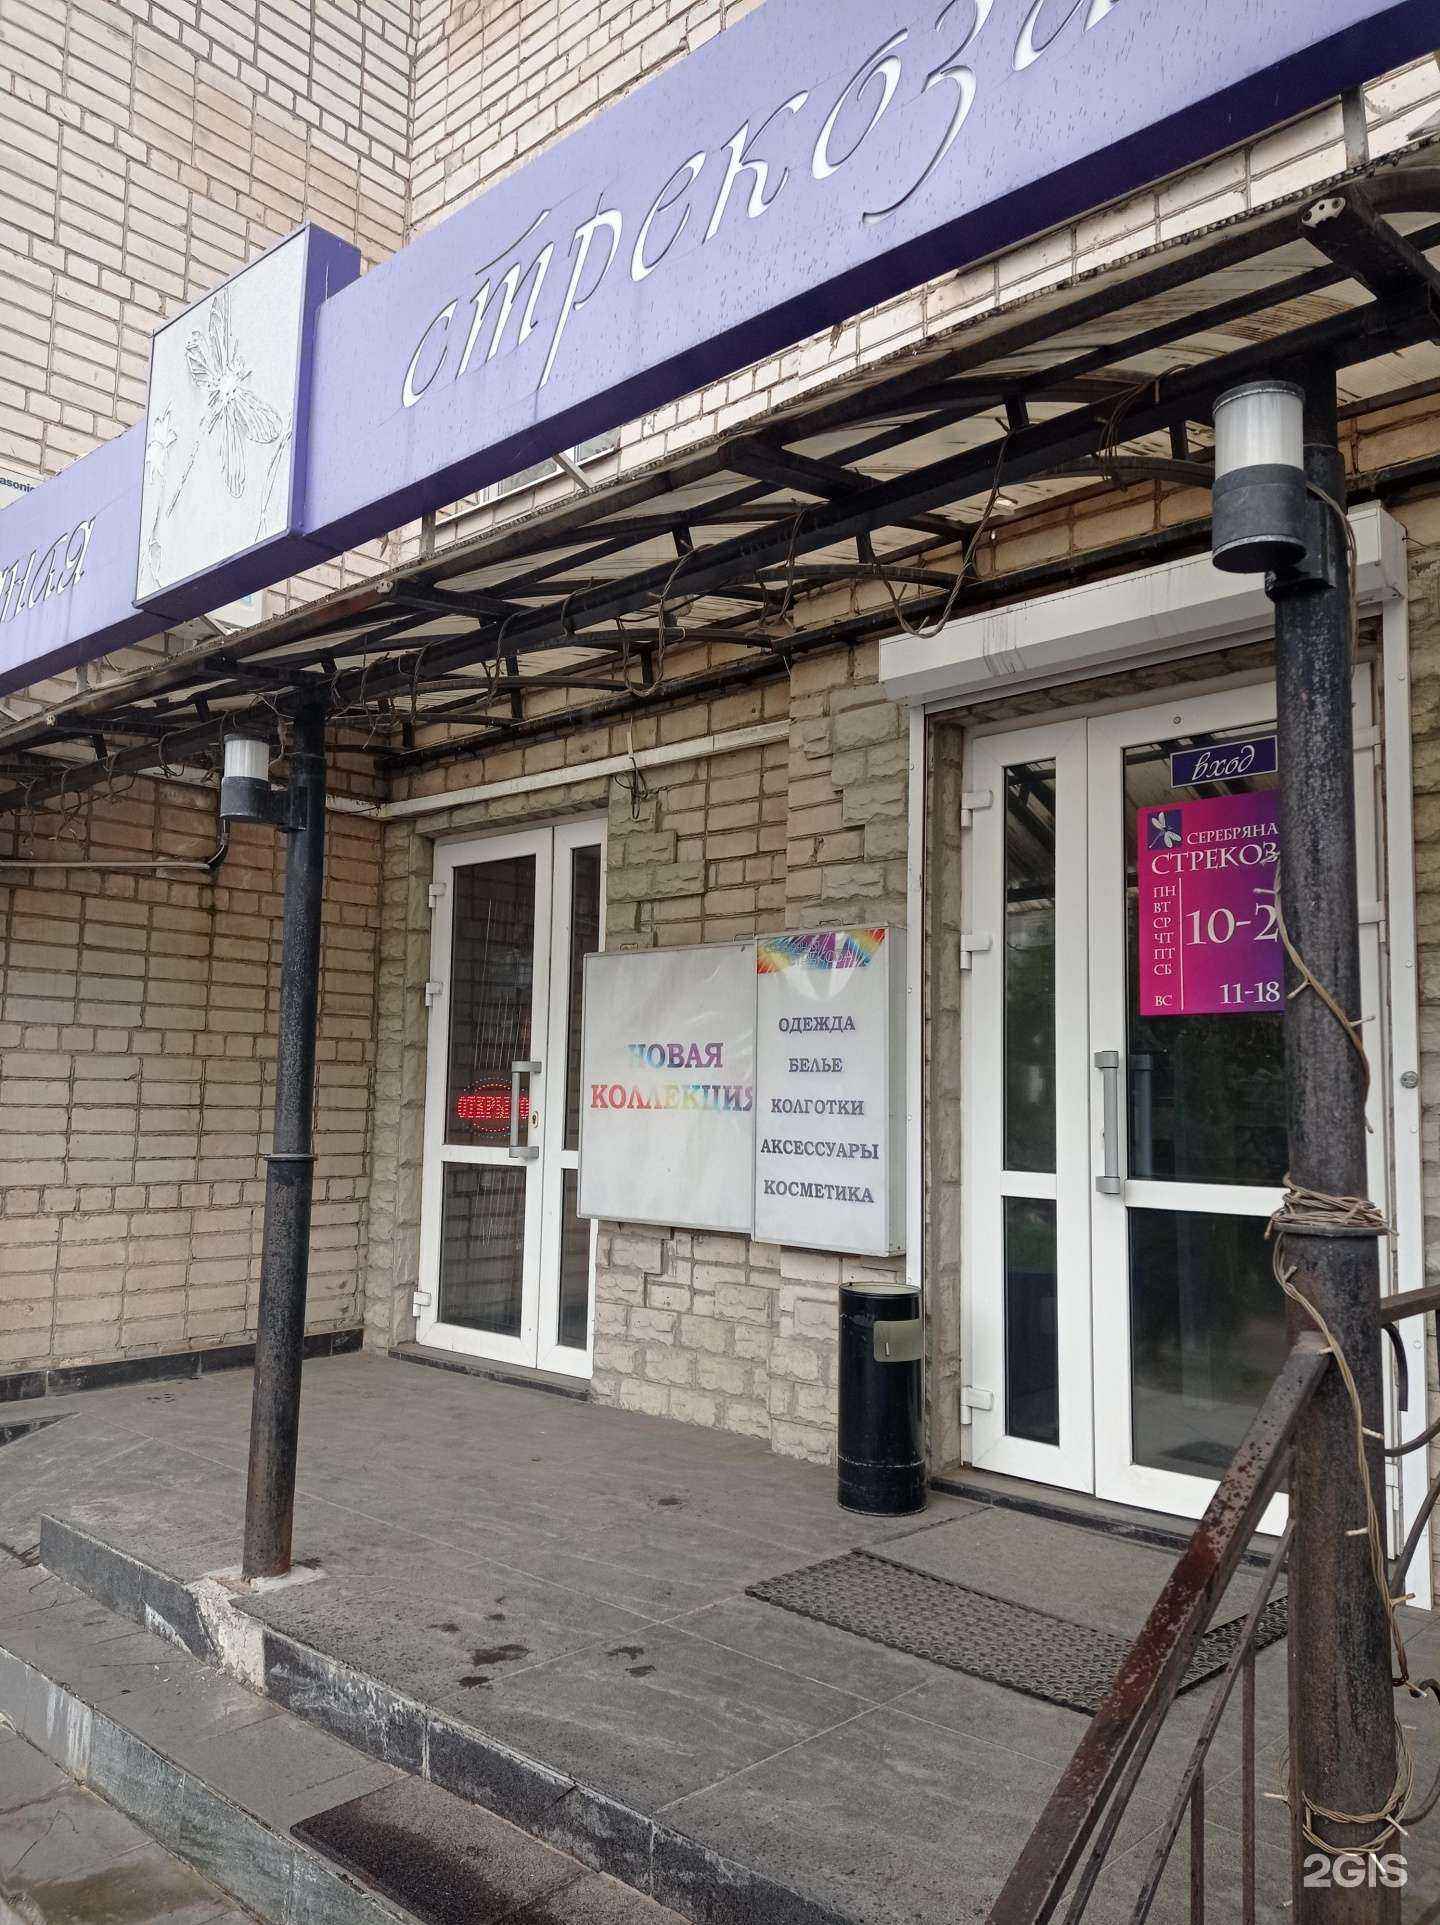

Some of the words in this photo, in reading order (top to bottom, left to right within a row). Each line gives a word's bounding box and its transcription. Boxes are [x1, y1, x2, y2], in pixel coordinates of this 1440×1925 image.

[0, 514, 96, 624] ная
[1191, 745, 1255, 782] вход
[1187, 822, 1279, 845] СЕРЕБРЯНА
[1151, 841, 1279, 875] СТРЕКОЗ
[1153, 885, 1177, 898] ПН
[1153, 901, 1171, 913] ВТ
[1153, 917, 1171, 929] СР
[1154, 932, 1174, 944] ЧТ
[1153, 947, 1175, 960] ПТ
[1153, 963, 1172, 976] СБ
[1154, 994, 1173, 1007] ВС
[1219, 981, 1280, 1004] 11-18
[778, 1015, 856, 1033] ОДЕЖДА
[788, 1057, 843, 1073] БЕЛЬЕ
[457, 1095, 530, 1120] ОТКРЫО
[770, 1098, 865, 1116] КОЛГОТКИ
[760, 1138, 880, 1160] АКСЕССУАРЫ
[763, 1179, 875, 1204] КОСМЕТИКА
